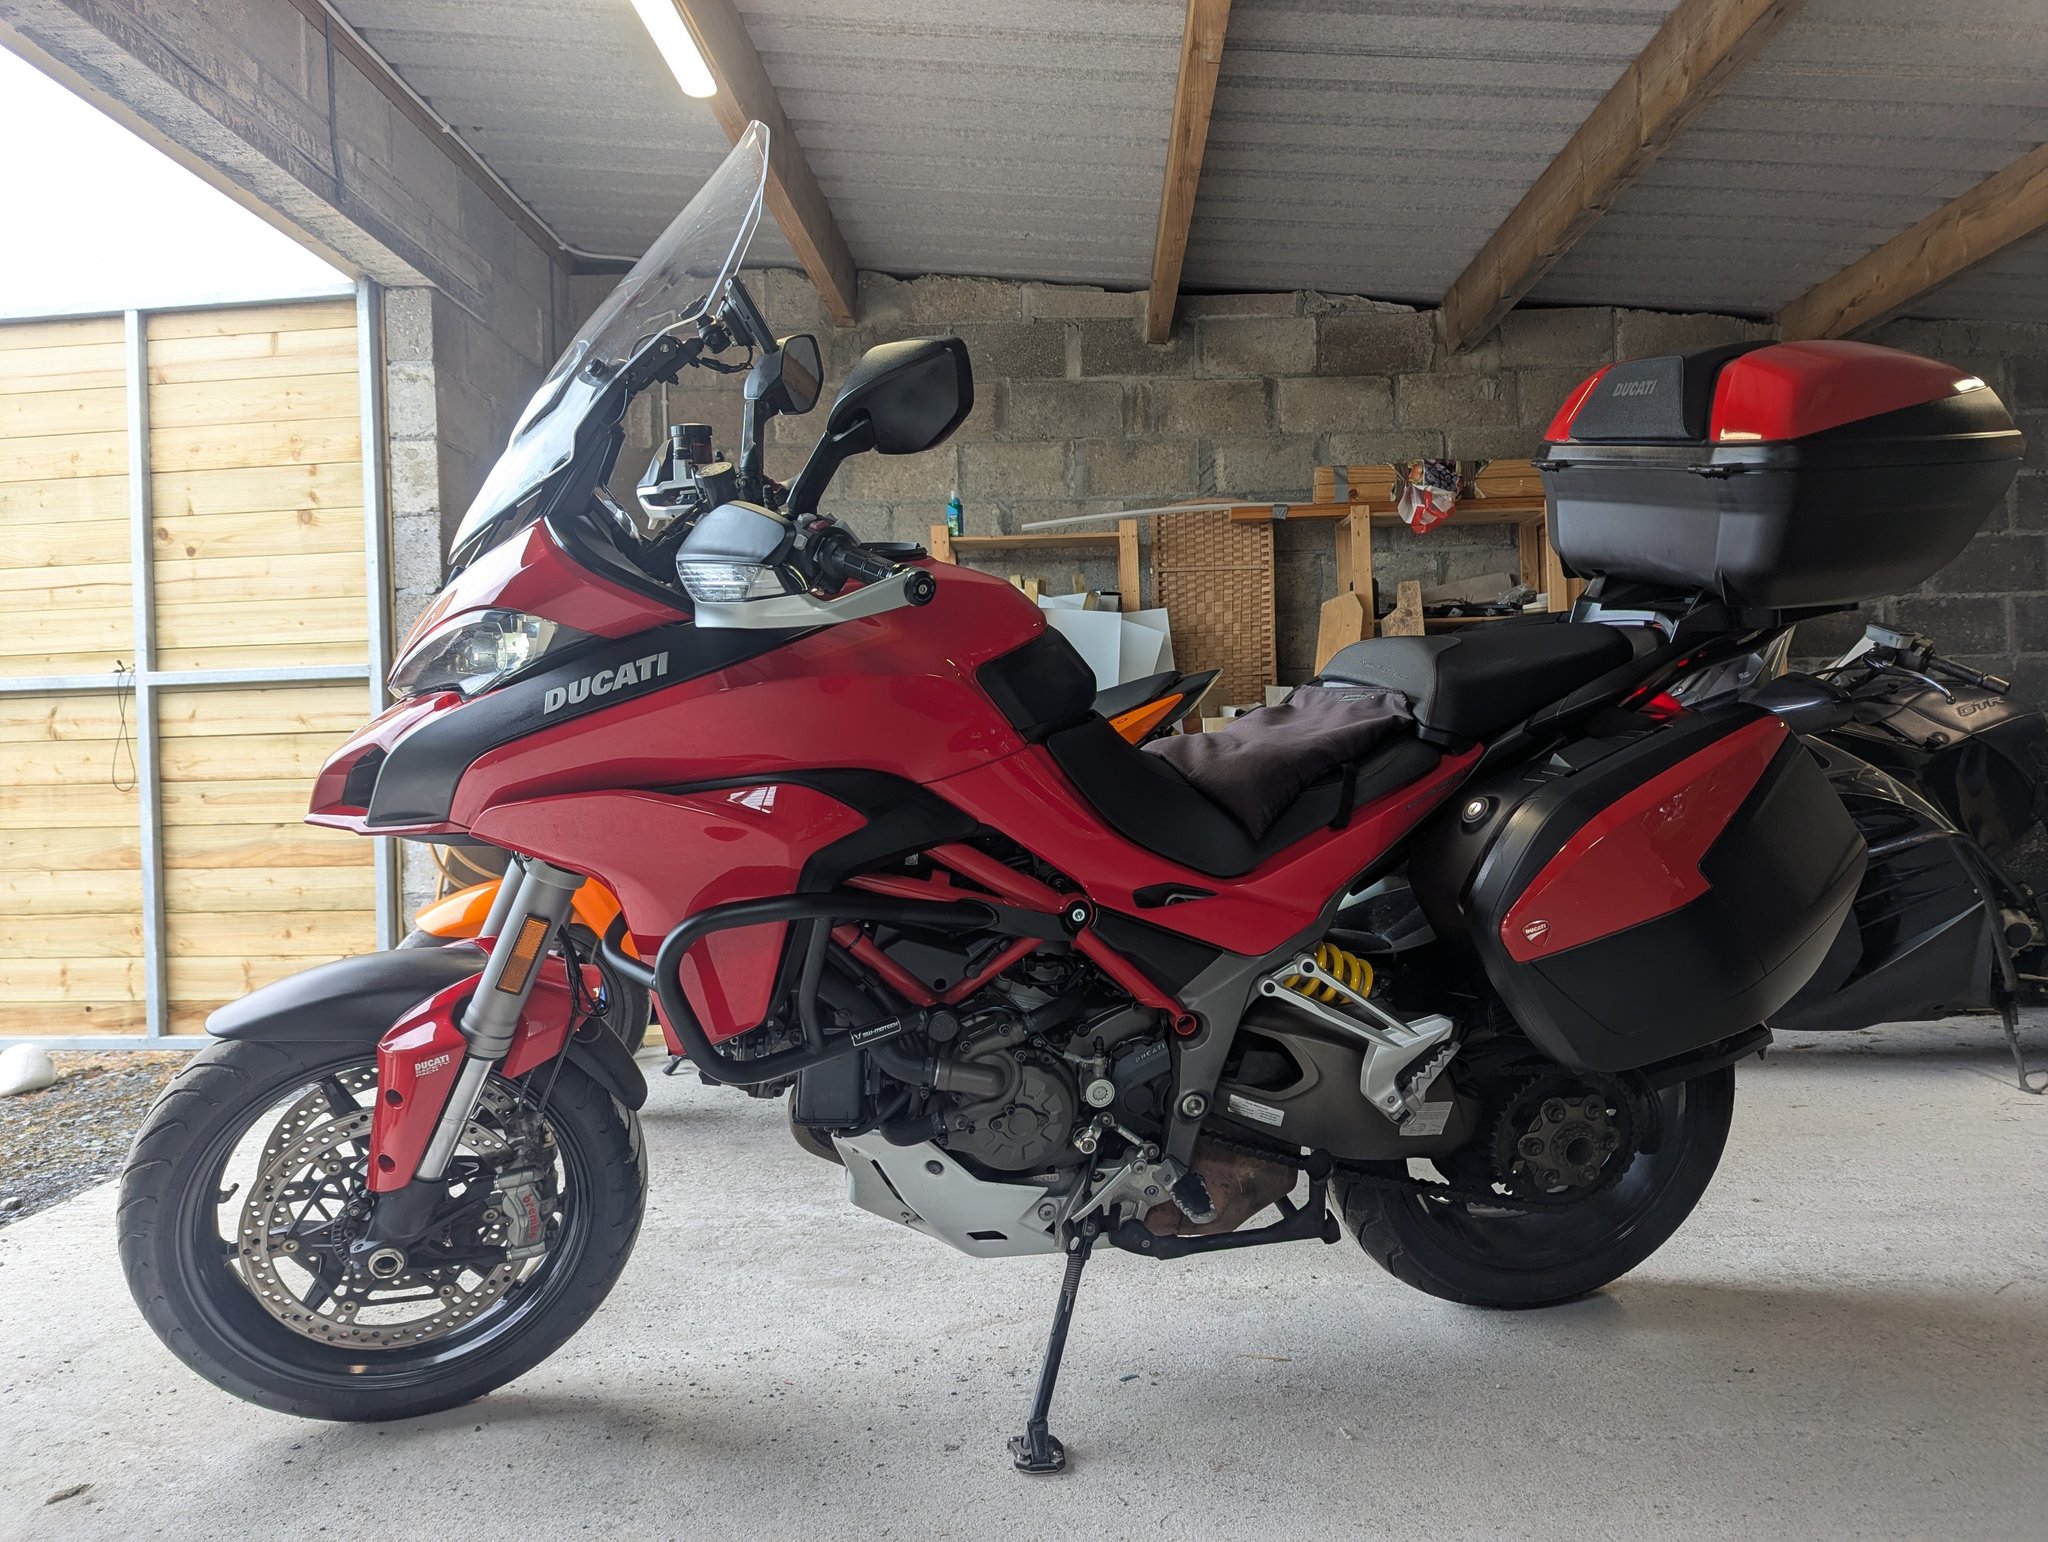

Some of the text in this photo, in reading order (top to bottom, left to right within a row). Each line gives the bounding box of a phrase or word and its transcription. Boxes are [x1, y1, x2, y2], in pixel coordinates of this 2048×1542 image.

[1612, 378, 1658, 397] DUCATI
[544, 651, 669, 715] DUCATI
[1956, 696, 2005, 717] GTR
[1525, 923, 1547, 935] DUCATI
[414, 1054, 450, 1070] DUCATI
[1135, 1042, 1165, 1063] DUCATI
[522, 1192, 540, 1240] brembo
